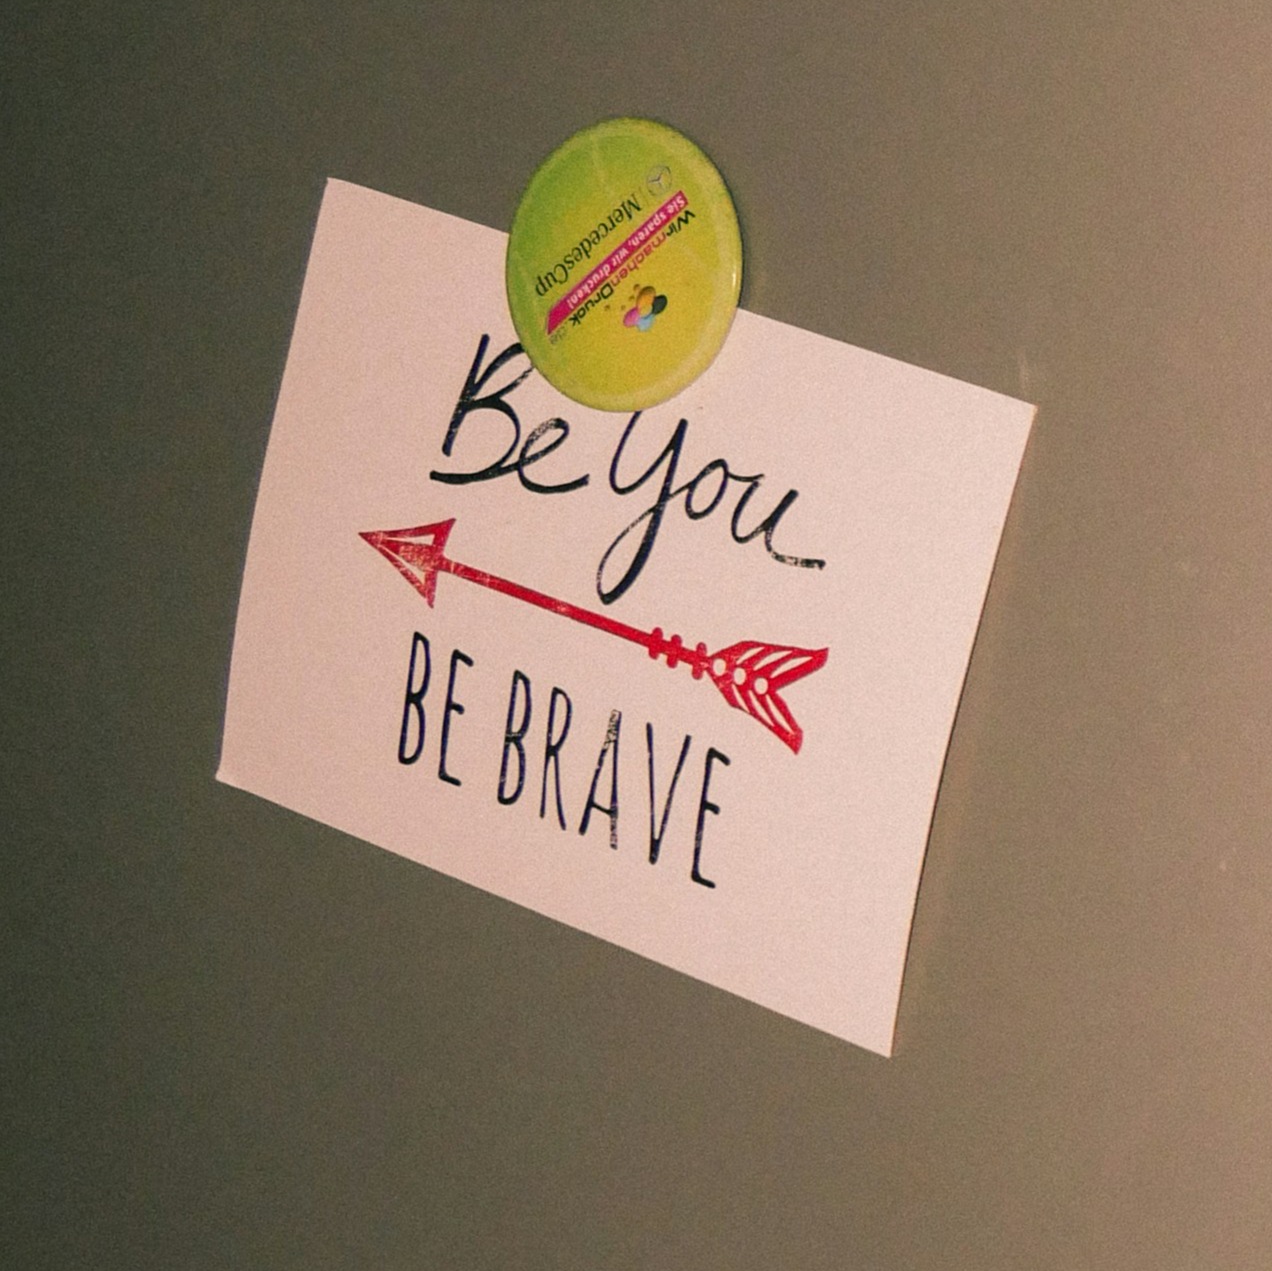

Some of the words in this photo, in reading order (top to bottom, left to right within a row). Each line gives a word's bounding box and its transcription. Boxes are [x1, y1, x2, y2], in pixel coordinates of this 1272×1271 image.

[665, 195, 686, 215] Sie
[535, 192, 643, 297] MercedesCup
[627, 213, 667, 248] sparen,
[608, 248, 630, 269] wir
[567, 264, 611, 310] drucken!
[429, 333, 590, 494] Be
[398, 631, 474, 787] BE
[497, 669, 732, 890] BRAVE
